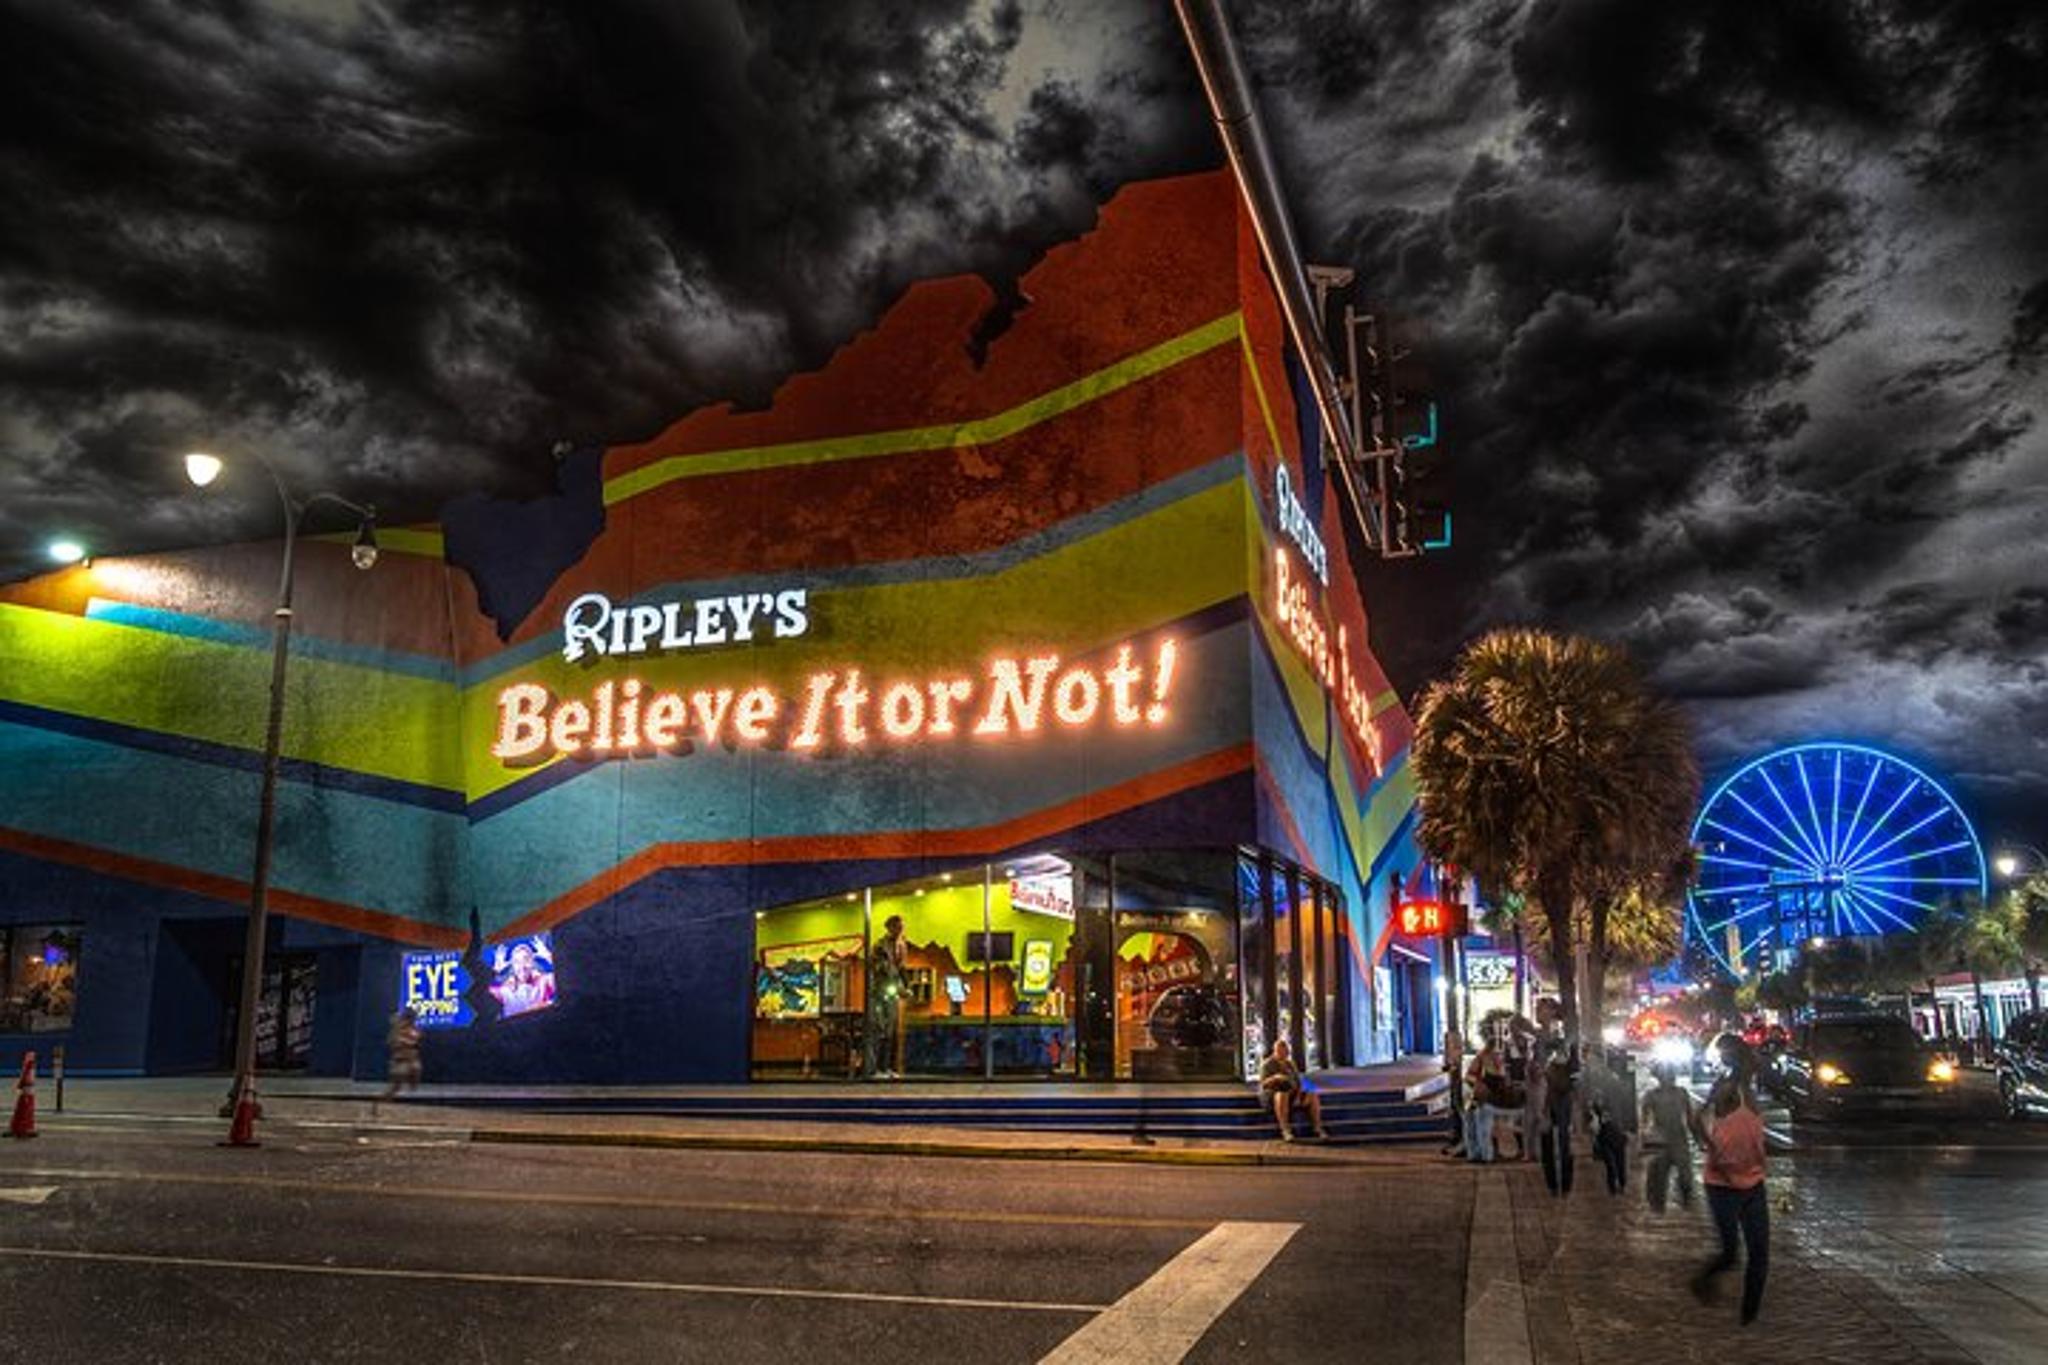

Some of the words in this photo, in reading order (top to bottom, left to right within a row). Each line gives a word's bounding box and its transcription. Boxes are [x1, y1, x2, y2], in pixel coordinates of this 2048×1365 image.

[492, 678, 777, 760] Believe
[791, 668, 869, 751] It
[881, 676, 974, 737] or
[975, 637, 1179, 735] Not!
[408, 960, 459, 999] EYE
